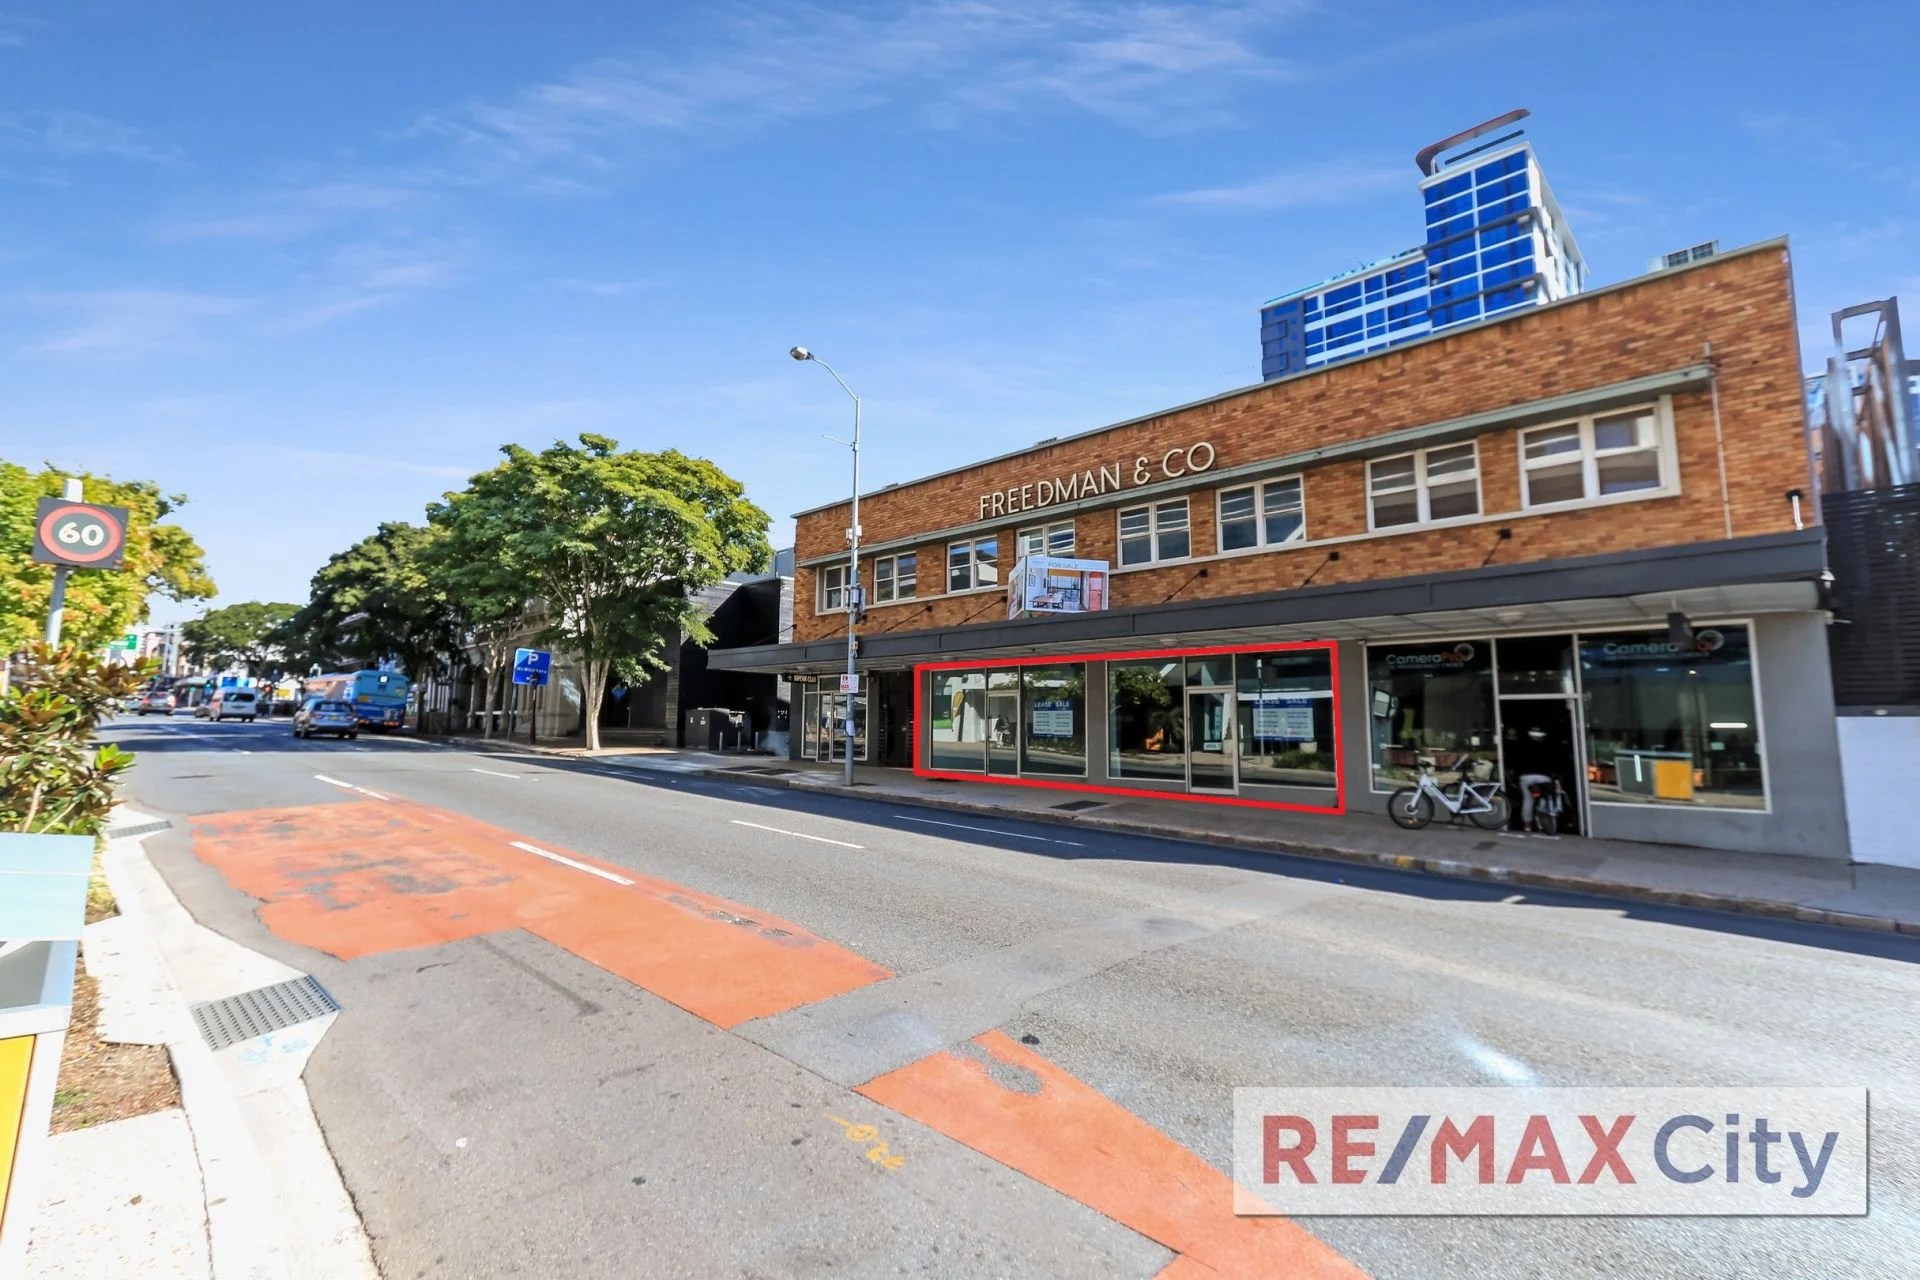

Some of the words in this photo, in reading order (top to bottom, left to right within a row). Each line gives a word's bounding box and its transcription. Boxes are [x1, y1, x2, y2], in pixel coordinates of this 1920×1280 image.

[979, 462, 1121, 520] FREEDMAN
[1133, 456, 1151, 485] &
[1162, 441, 1215, 478] CO
[58, 521, 104, 547] 60
[528, 653, 539, 665] P
[1386, 651, 1464, 665] CameraPro
